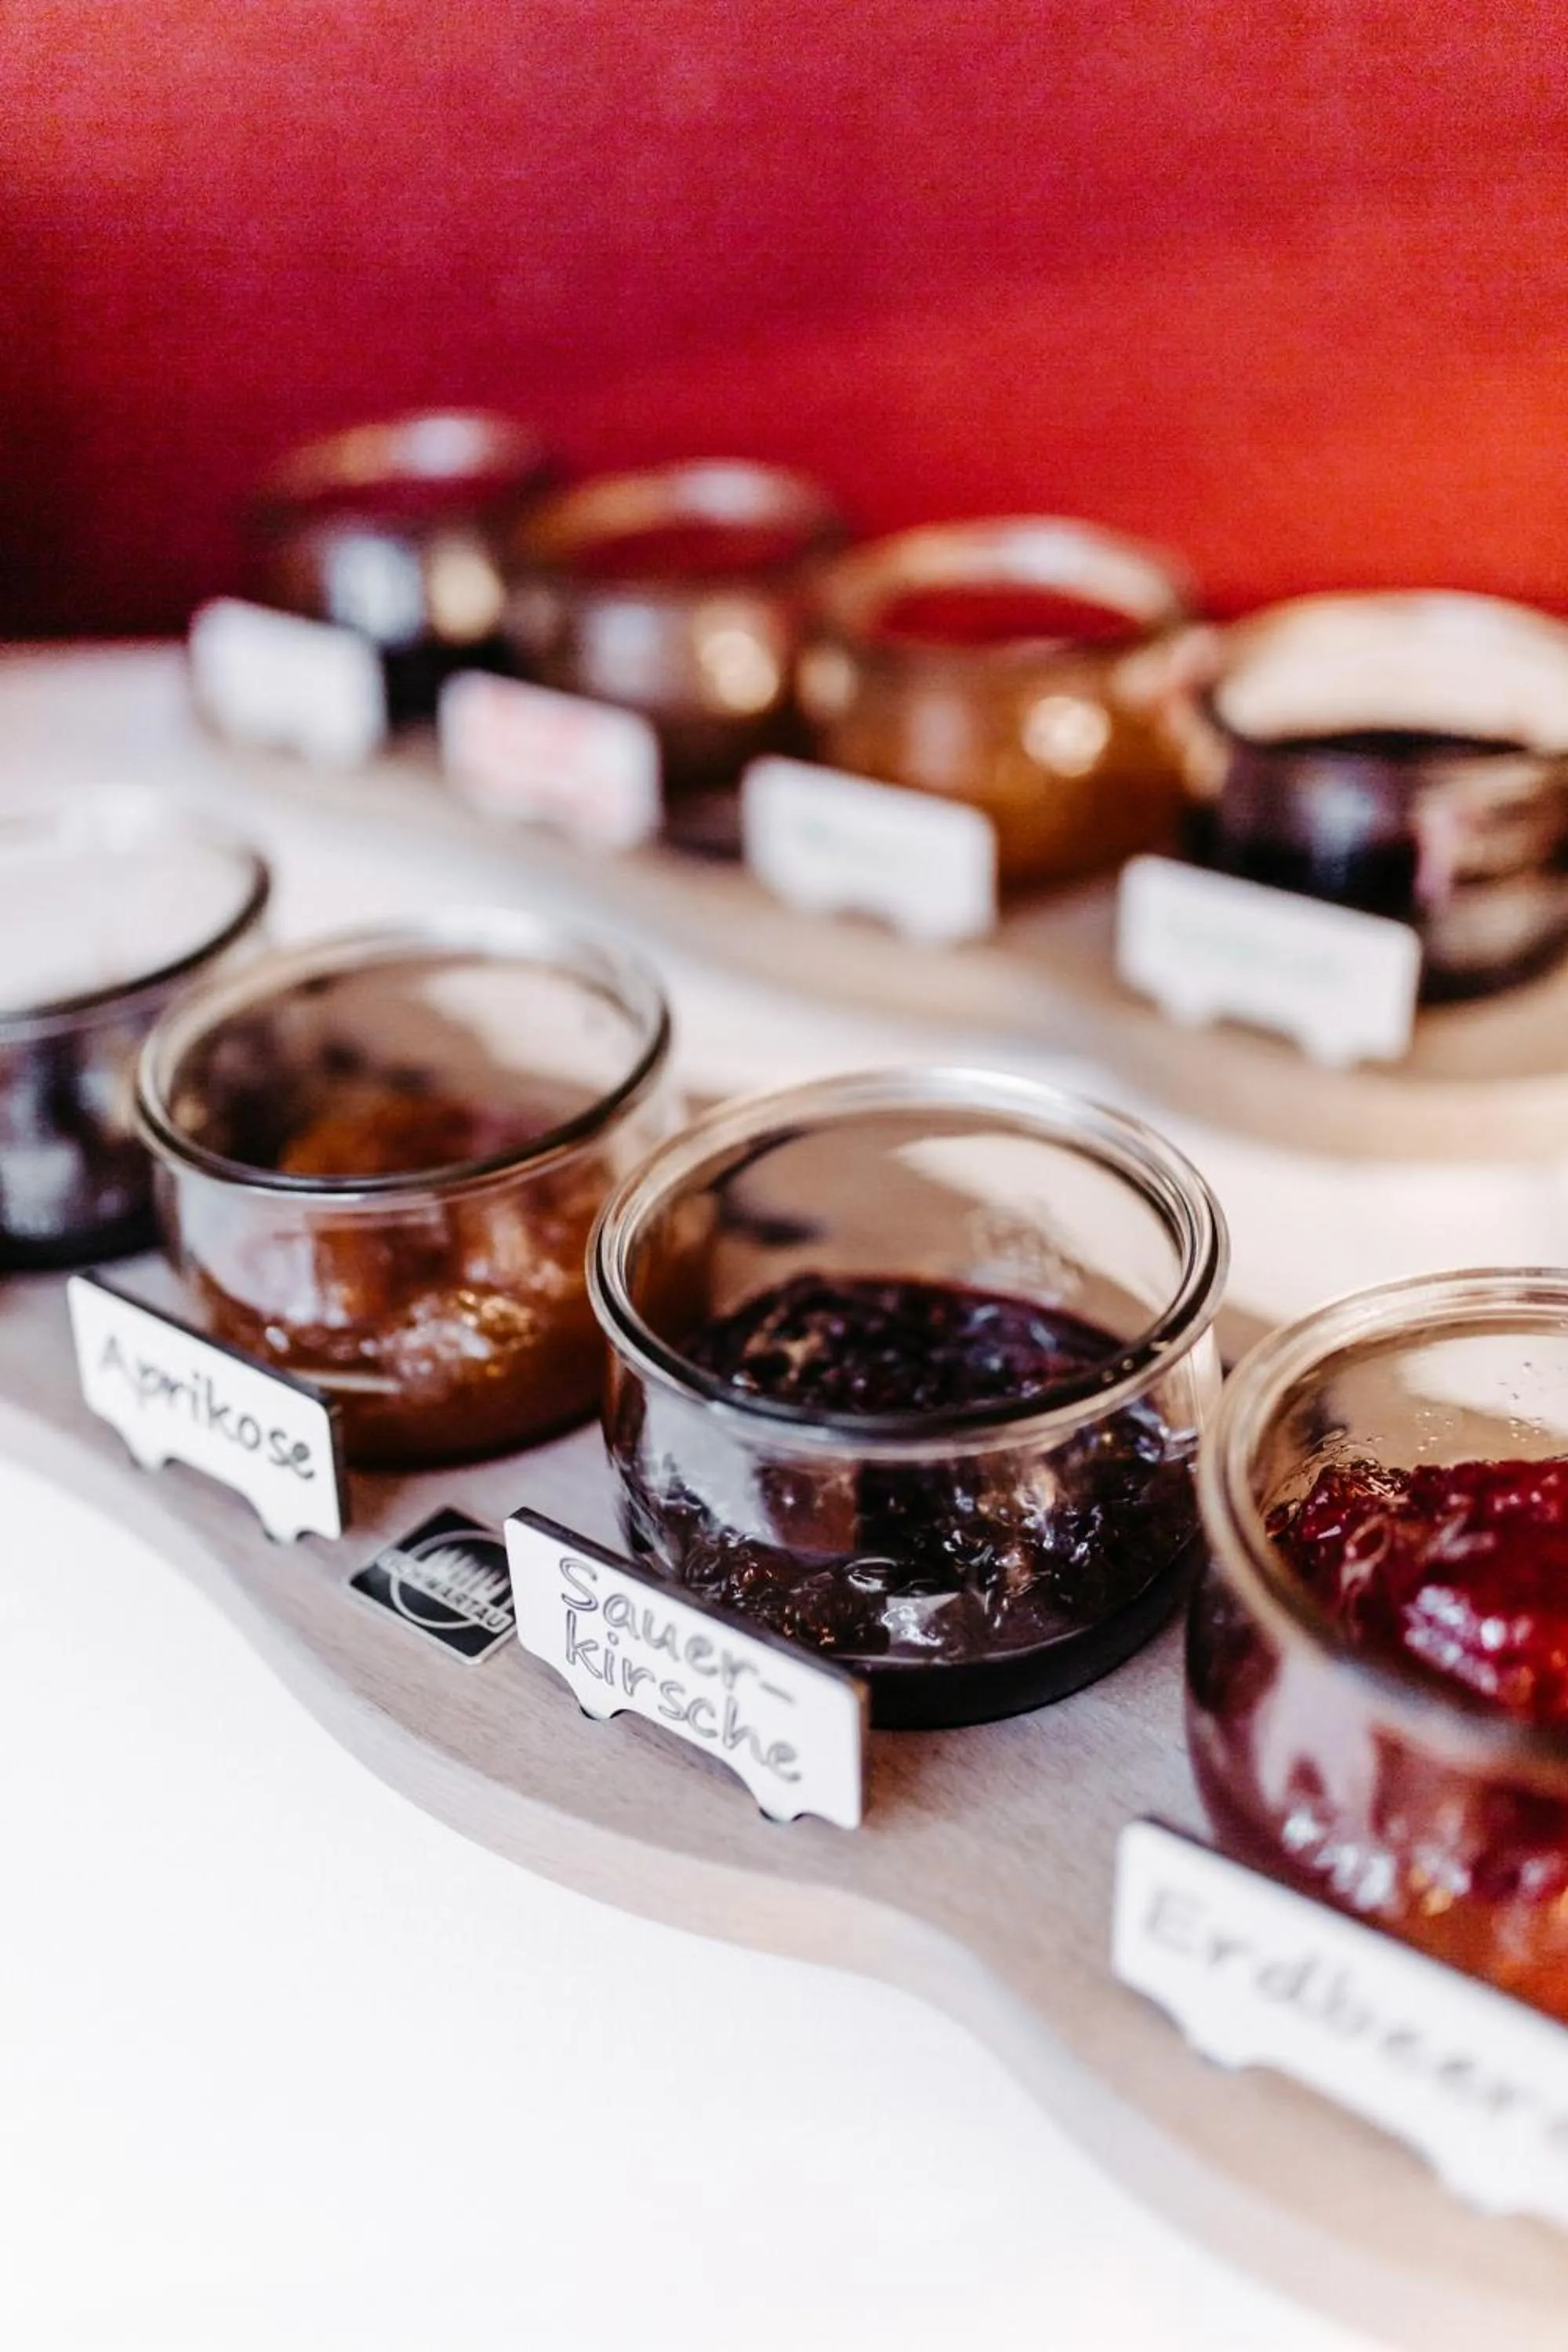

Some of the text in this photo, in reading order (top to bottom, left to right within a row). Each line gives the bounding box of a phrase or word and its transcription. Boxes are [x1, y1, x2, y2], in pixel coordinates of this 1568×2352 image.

[96, 1335, 315, 1481] Aprikose
[384, 1551, 506, 1628] HWARTAU
[559, 1556, 797, 1705] Sauer-
[564, 1610, 803, 1783] kirsche
